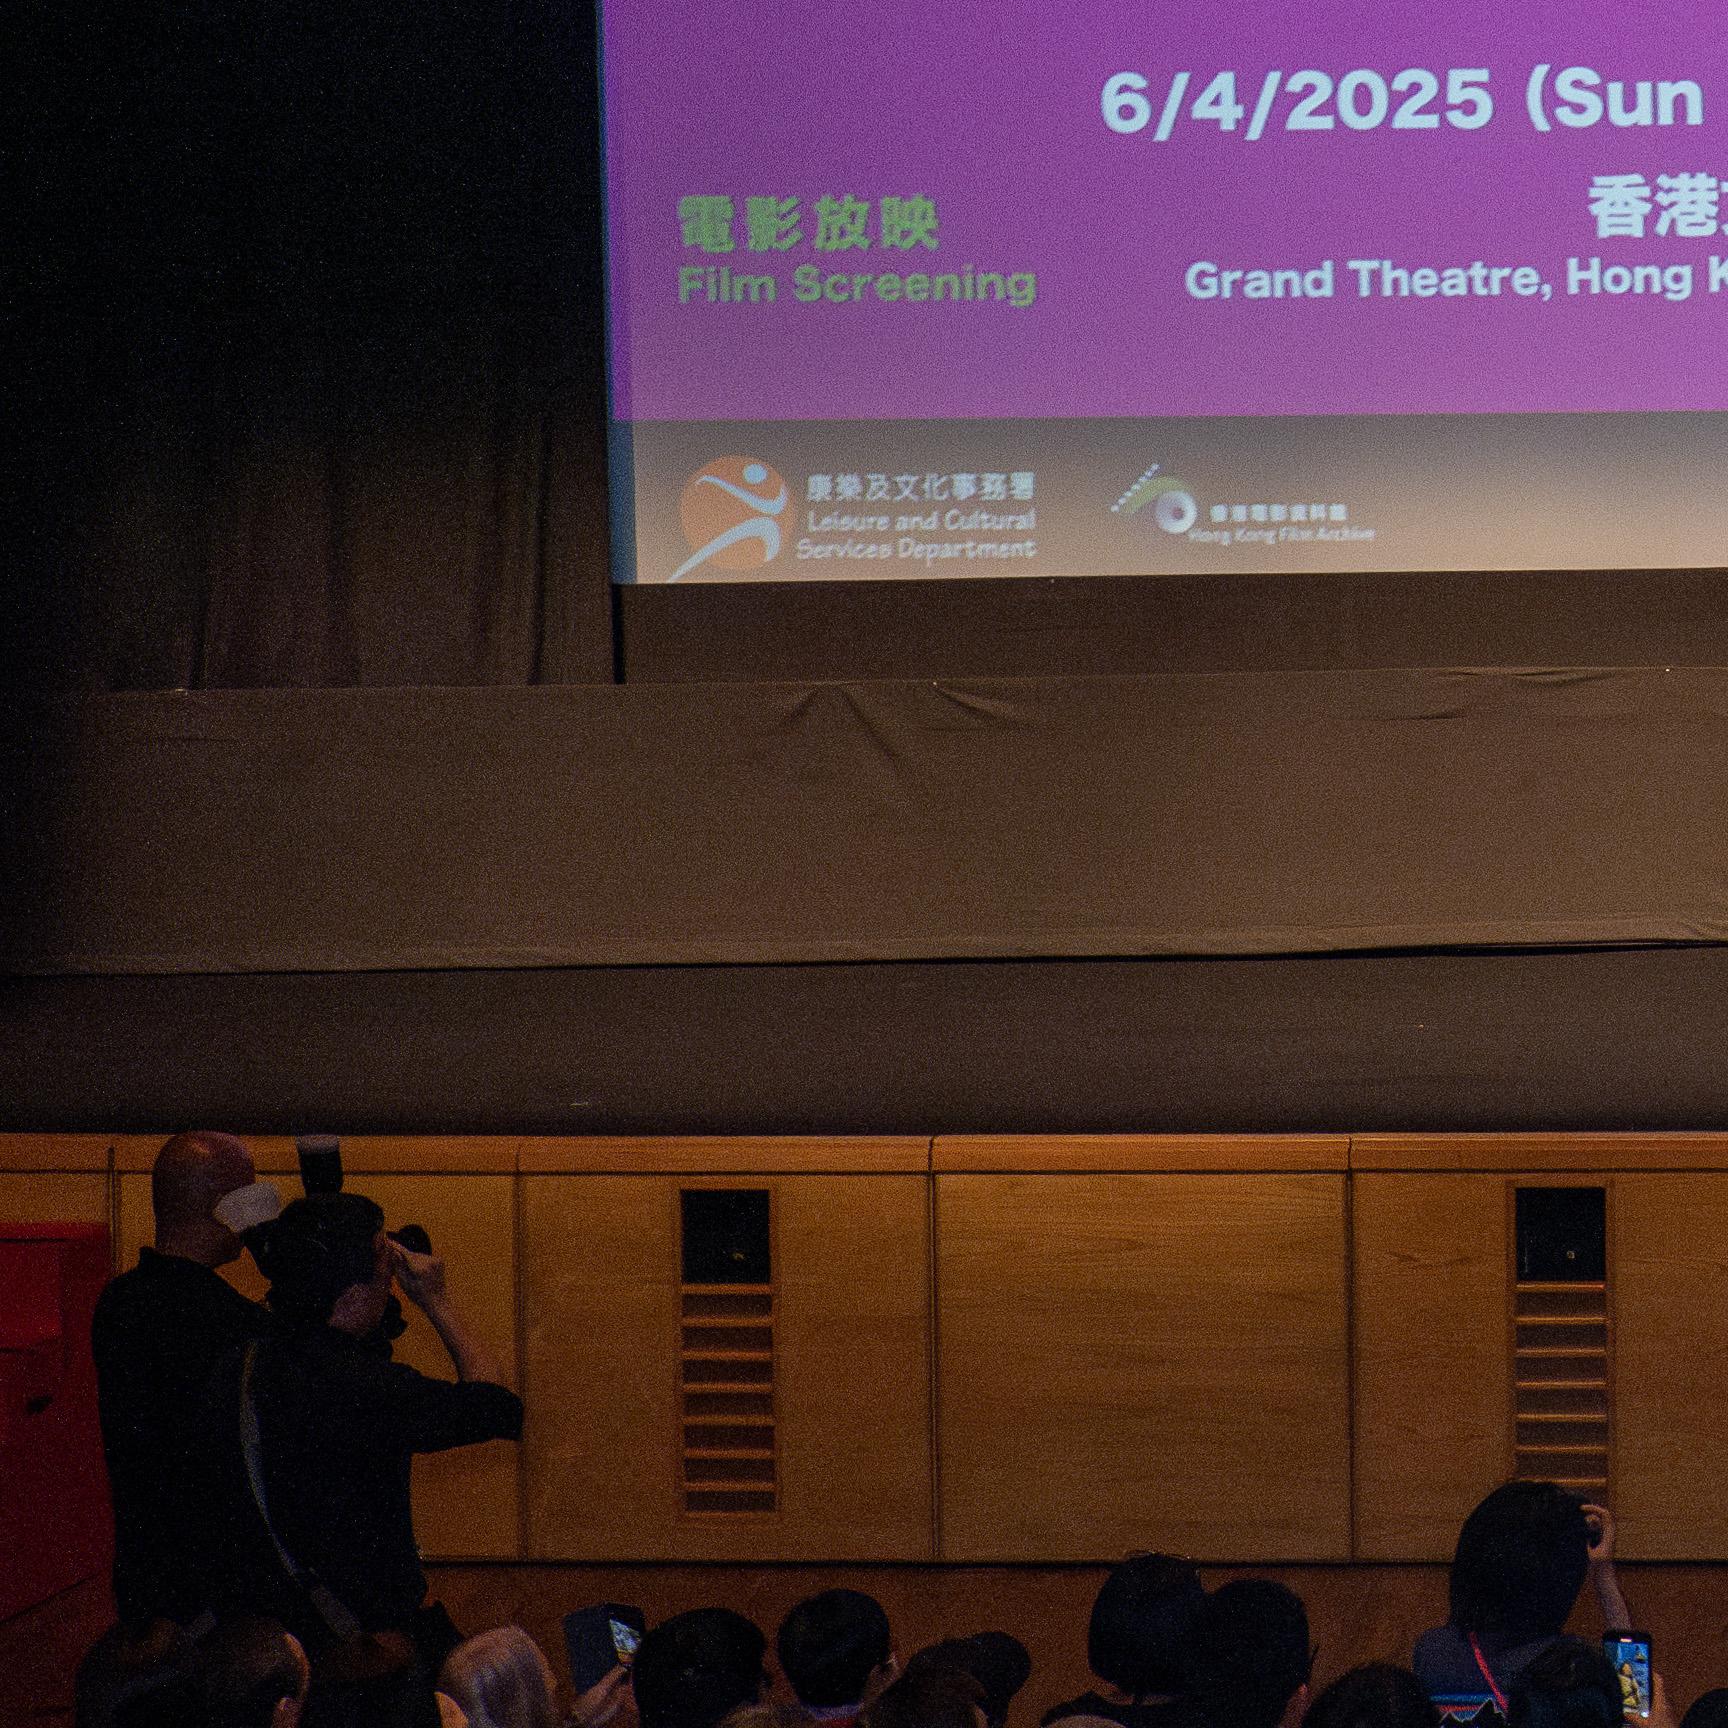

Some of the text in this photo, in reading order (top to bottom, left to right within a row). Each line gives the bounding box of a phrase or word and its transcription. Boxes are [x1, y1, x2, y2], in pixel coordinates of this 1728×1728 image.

[1101, 68, 1494, 141] 6/4/2025
[1526, 63, 1702, 132] (Sun
[677, 193, 940, 252] 電影放映
[679, 263, 1037, 308] Film Screening
[1185, 259, 1334, 300] Grand
[1347, 258, 1553, 302] Theatre,
[1567, 255, 1693, 301] Hong
[808, 507, 1036, 532] Leisure and Cultural
[797, 536, 1037, 566] Services Department
